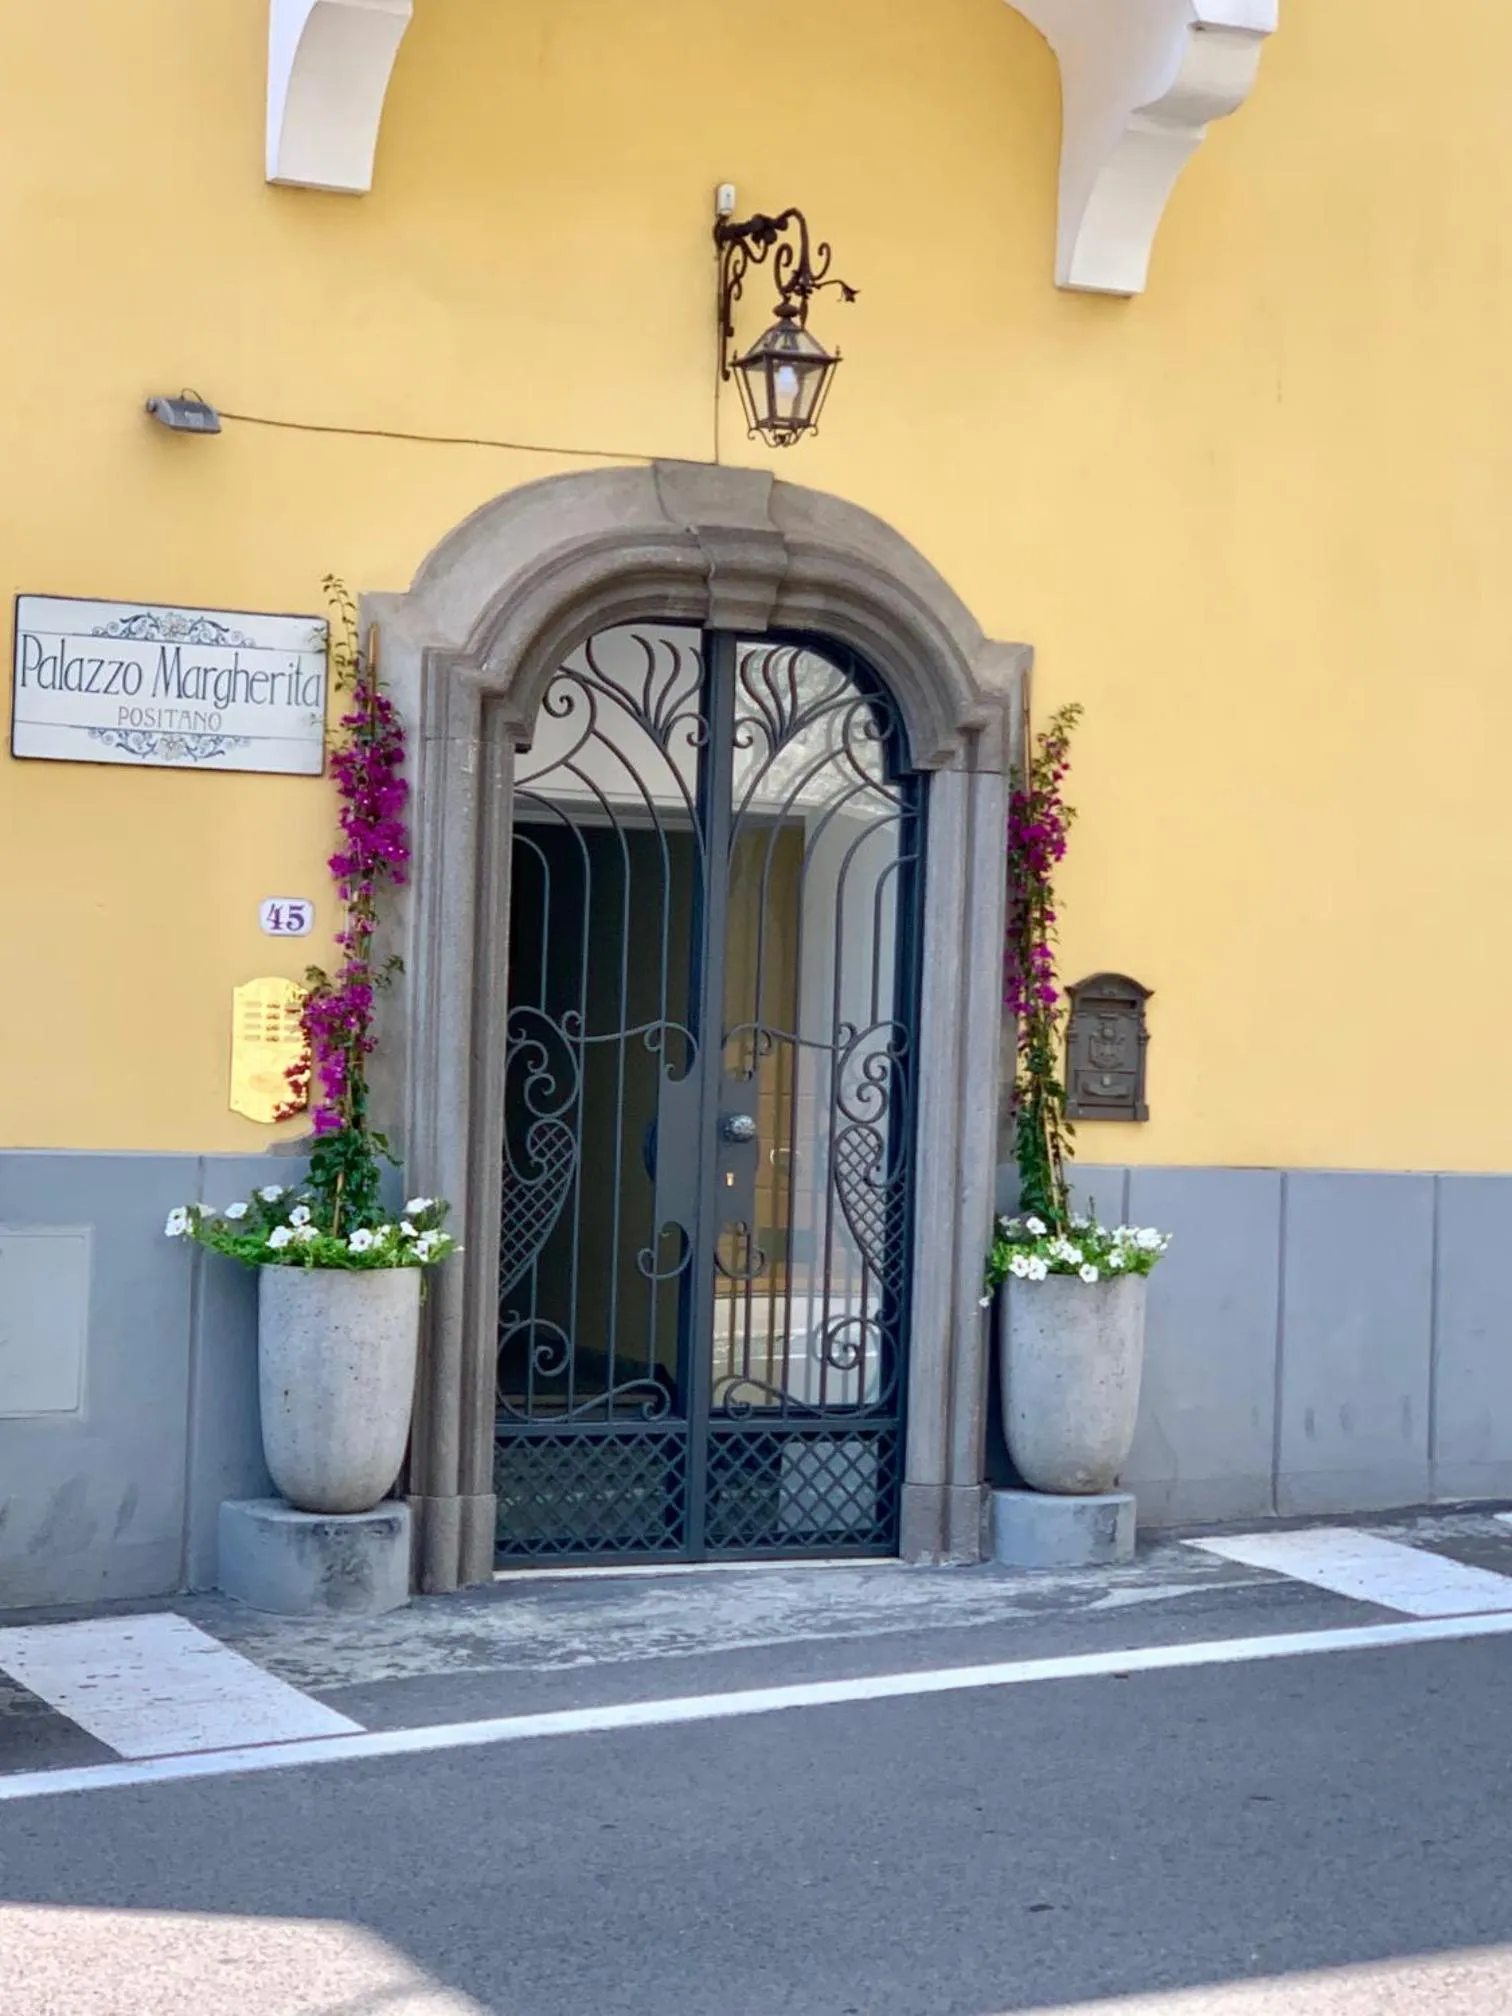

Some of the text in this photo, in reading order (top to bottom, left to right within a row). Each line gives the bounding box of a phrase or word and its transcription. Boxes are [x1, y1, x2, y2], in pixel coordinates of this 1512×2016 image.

[20, 633, 323, 710] Palazzo Margherita
[117, 706, 223, 732] POSITANO
[266, 903, 305, 931] 45
